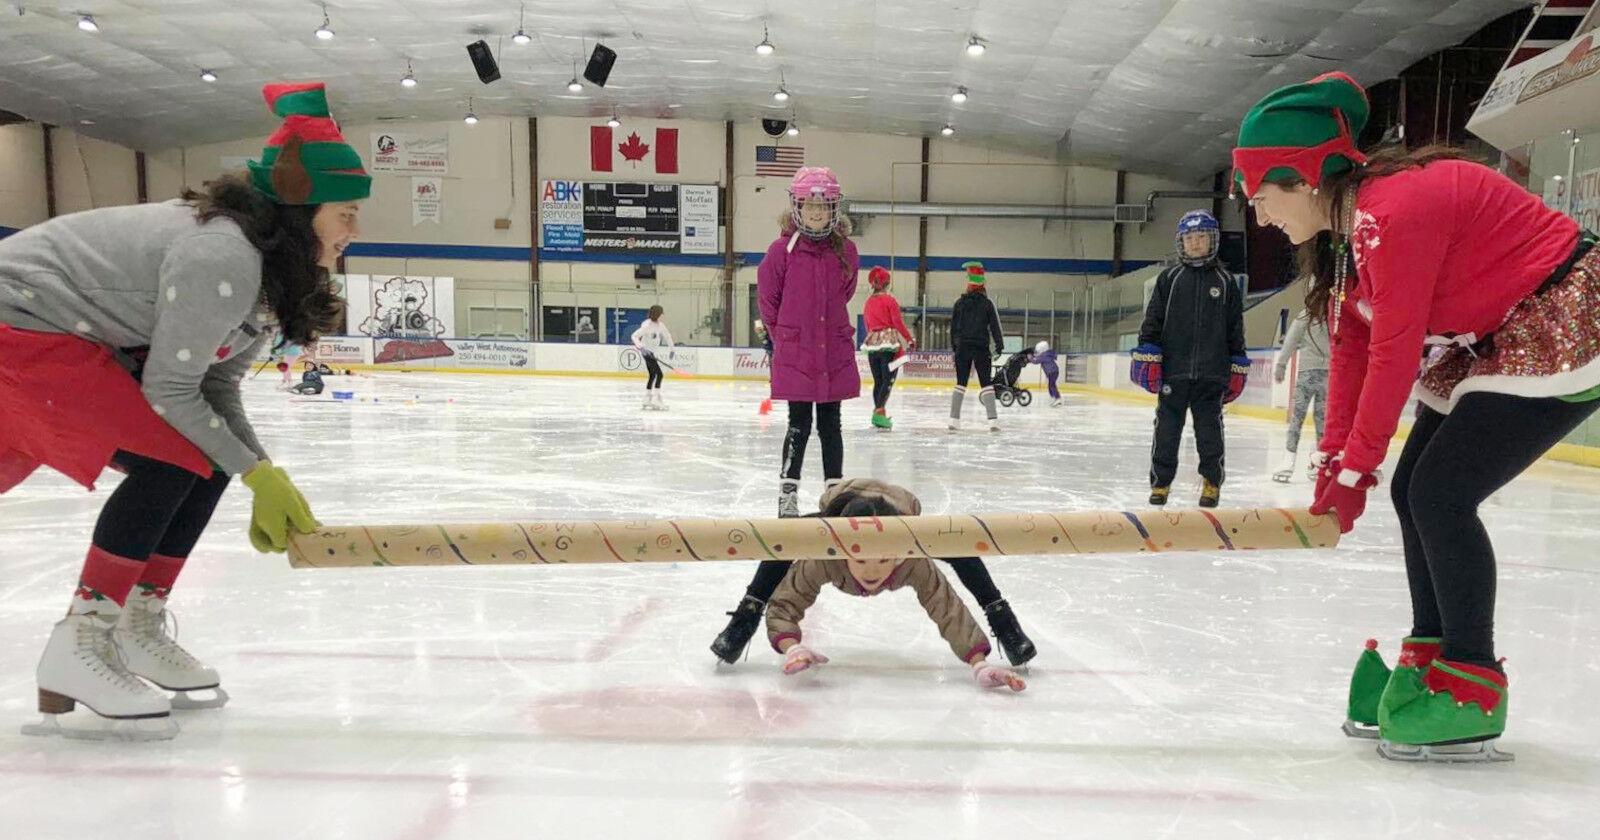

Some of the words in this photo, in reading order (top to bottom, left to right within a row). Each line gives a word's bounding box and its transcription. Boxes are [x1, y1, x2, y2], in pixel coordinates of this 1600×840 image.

[543, 181, 582, 201] ABK
[543, 202, 582, 210] restoration
[543, 211, 582, 219] services
[584, 238, 627, 247] NESTERS
[635, 240, 680, 248] MARKET
[457, 343, 475, 352] Valley
[477, 343, 491, 351] West
[736, 353, 758, 368] Tim
